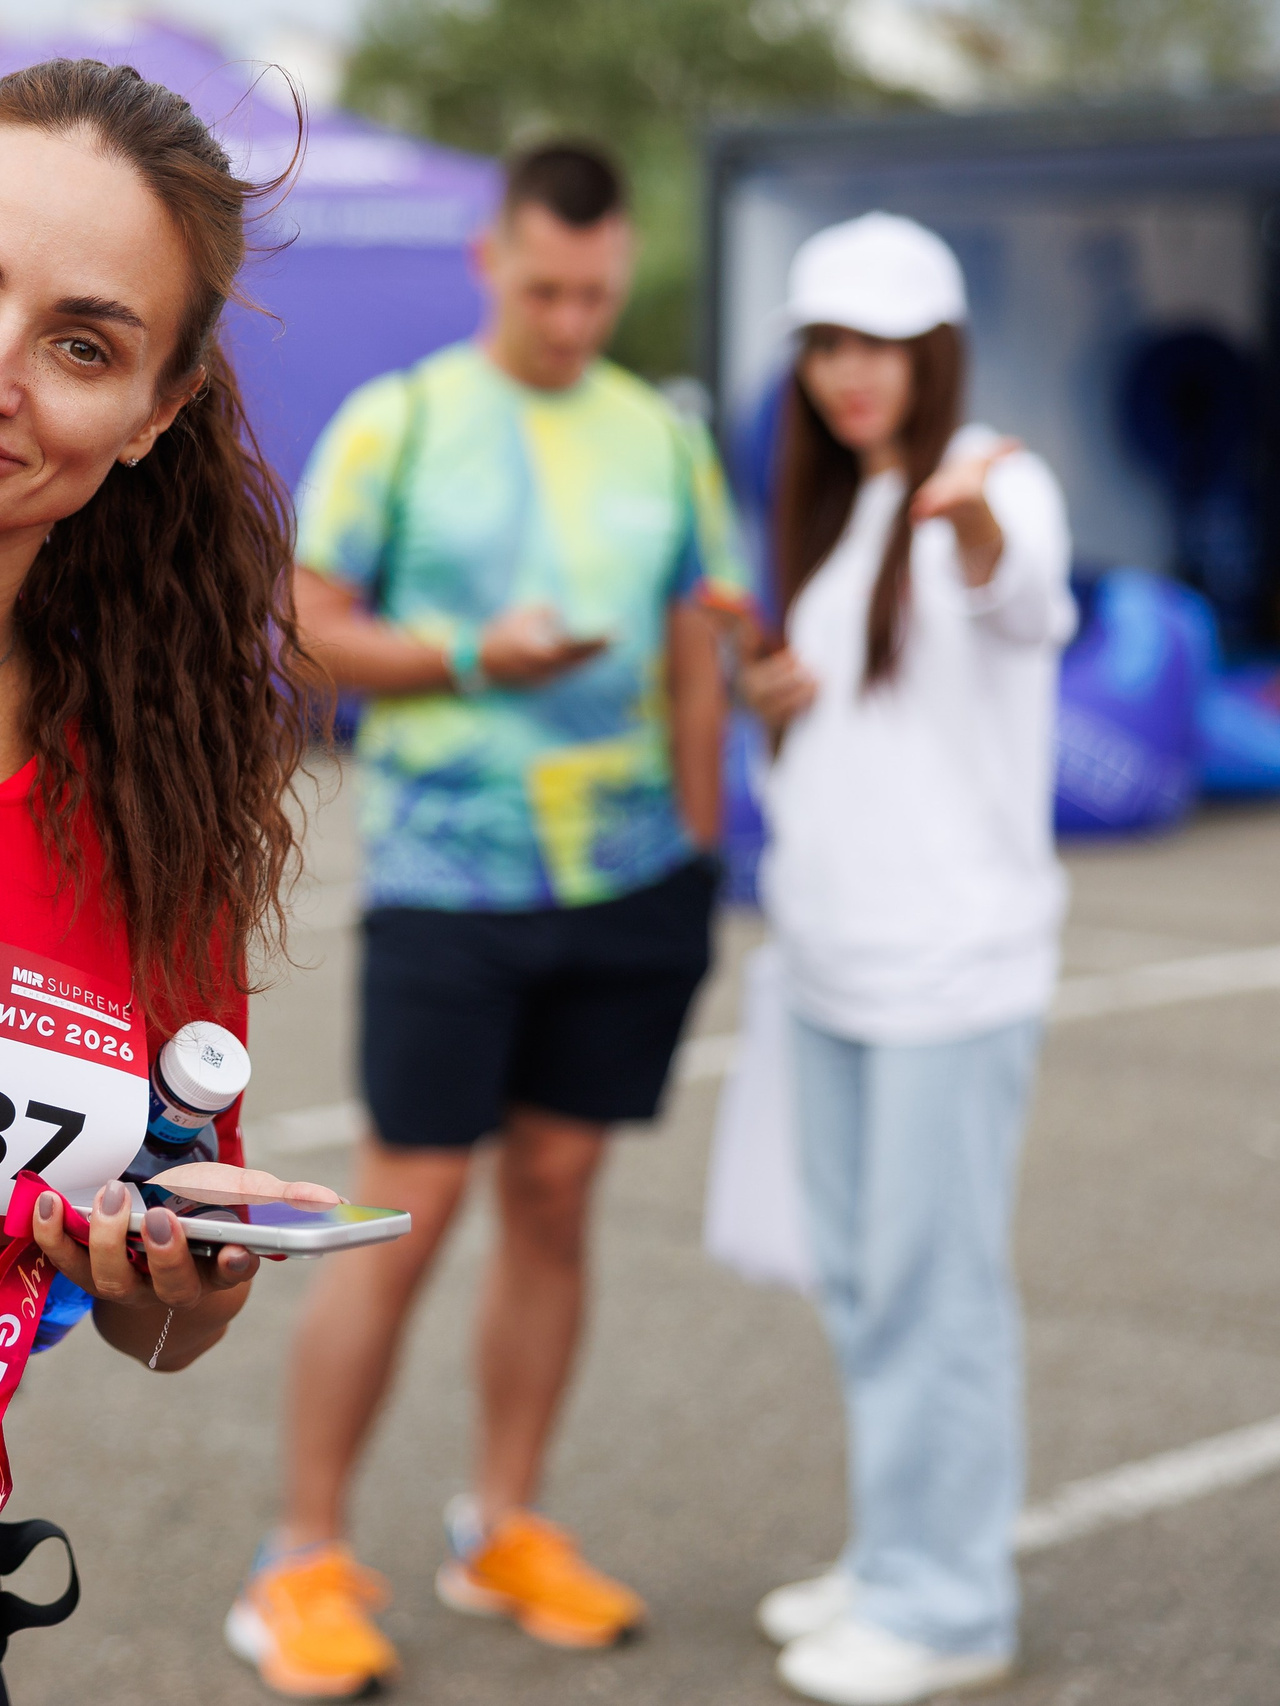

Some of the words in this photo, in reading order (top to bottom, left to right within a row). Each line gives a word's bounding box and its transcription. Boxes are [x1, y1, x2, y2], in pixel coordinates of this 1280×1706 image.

[12, 966, 44, 989] MIR
[47, 978, 132, 1021] SUPREME
[65, 1023, 134, 1062] 2026
